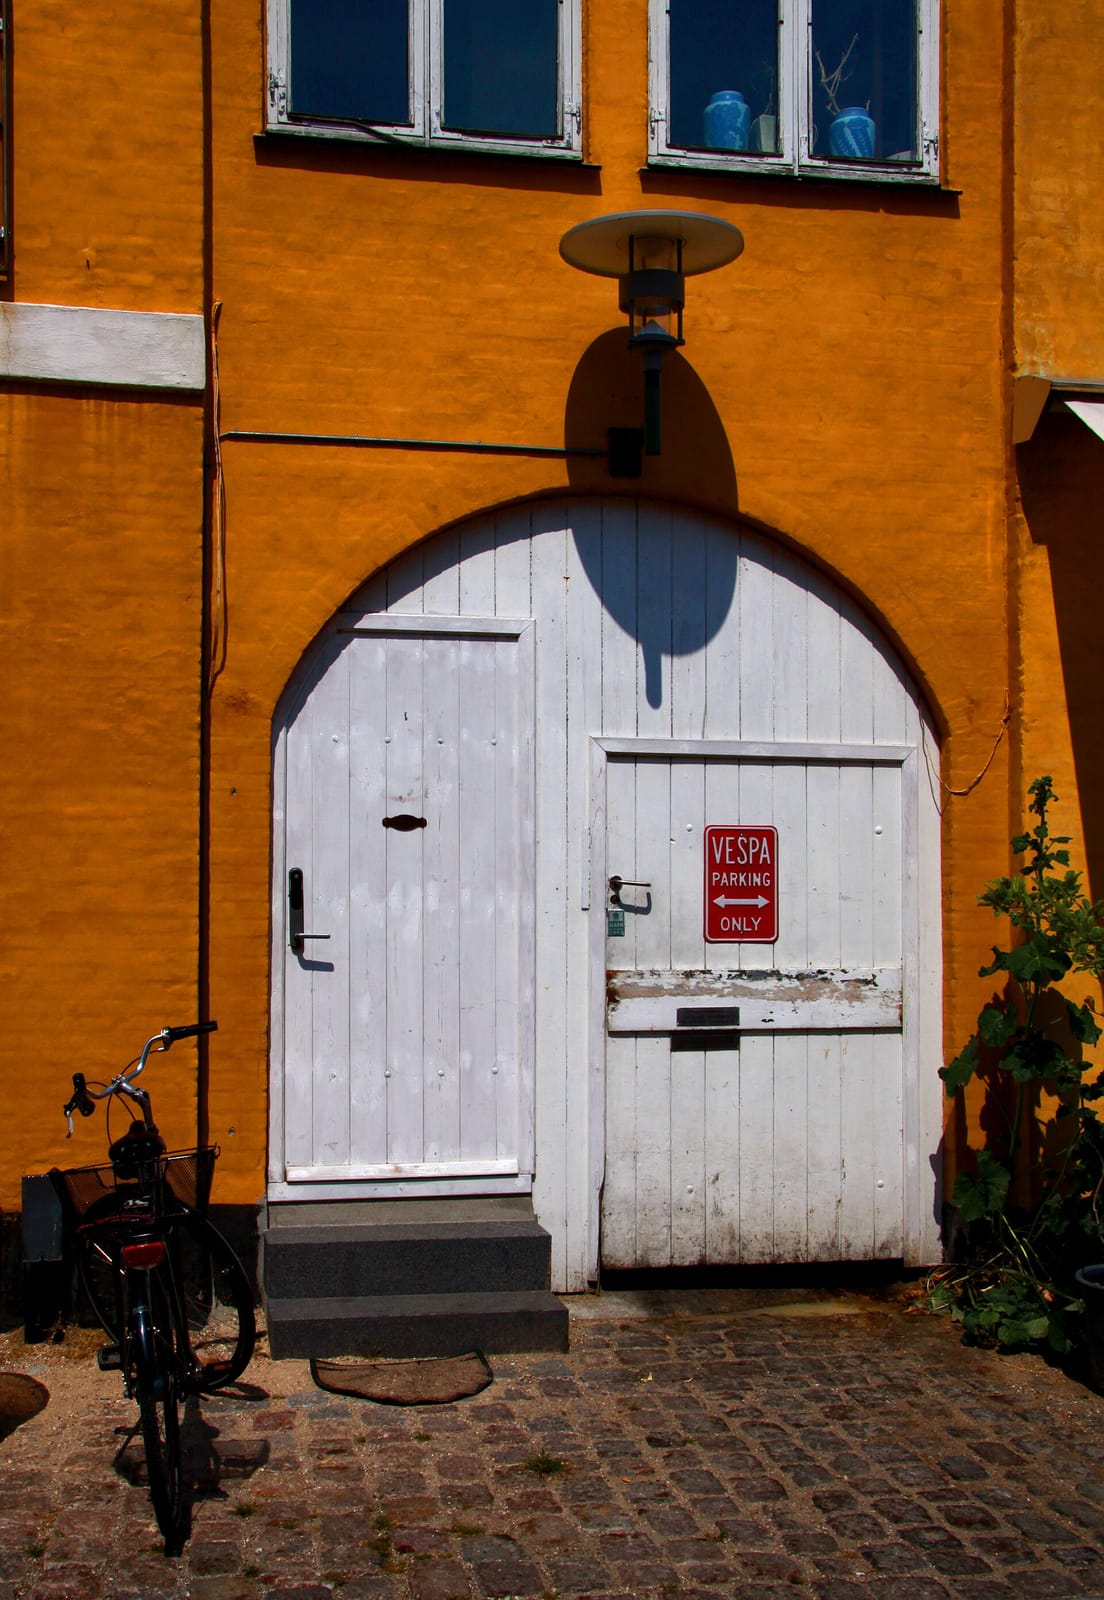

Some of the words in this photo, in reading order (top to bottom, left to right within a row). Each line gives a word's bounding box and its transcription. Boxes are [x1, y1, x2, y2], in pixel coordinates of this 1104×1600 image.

[712, 836, 771, 865] VESPA
[712, 872, 771, 887] PARKING
[720, 917, 762, 932] ONLY
